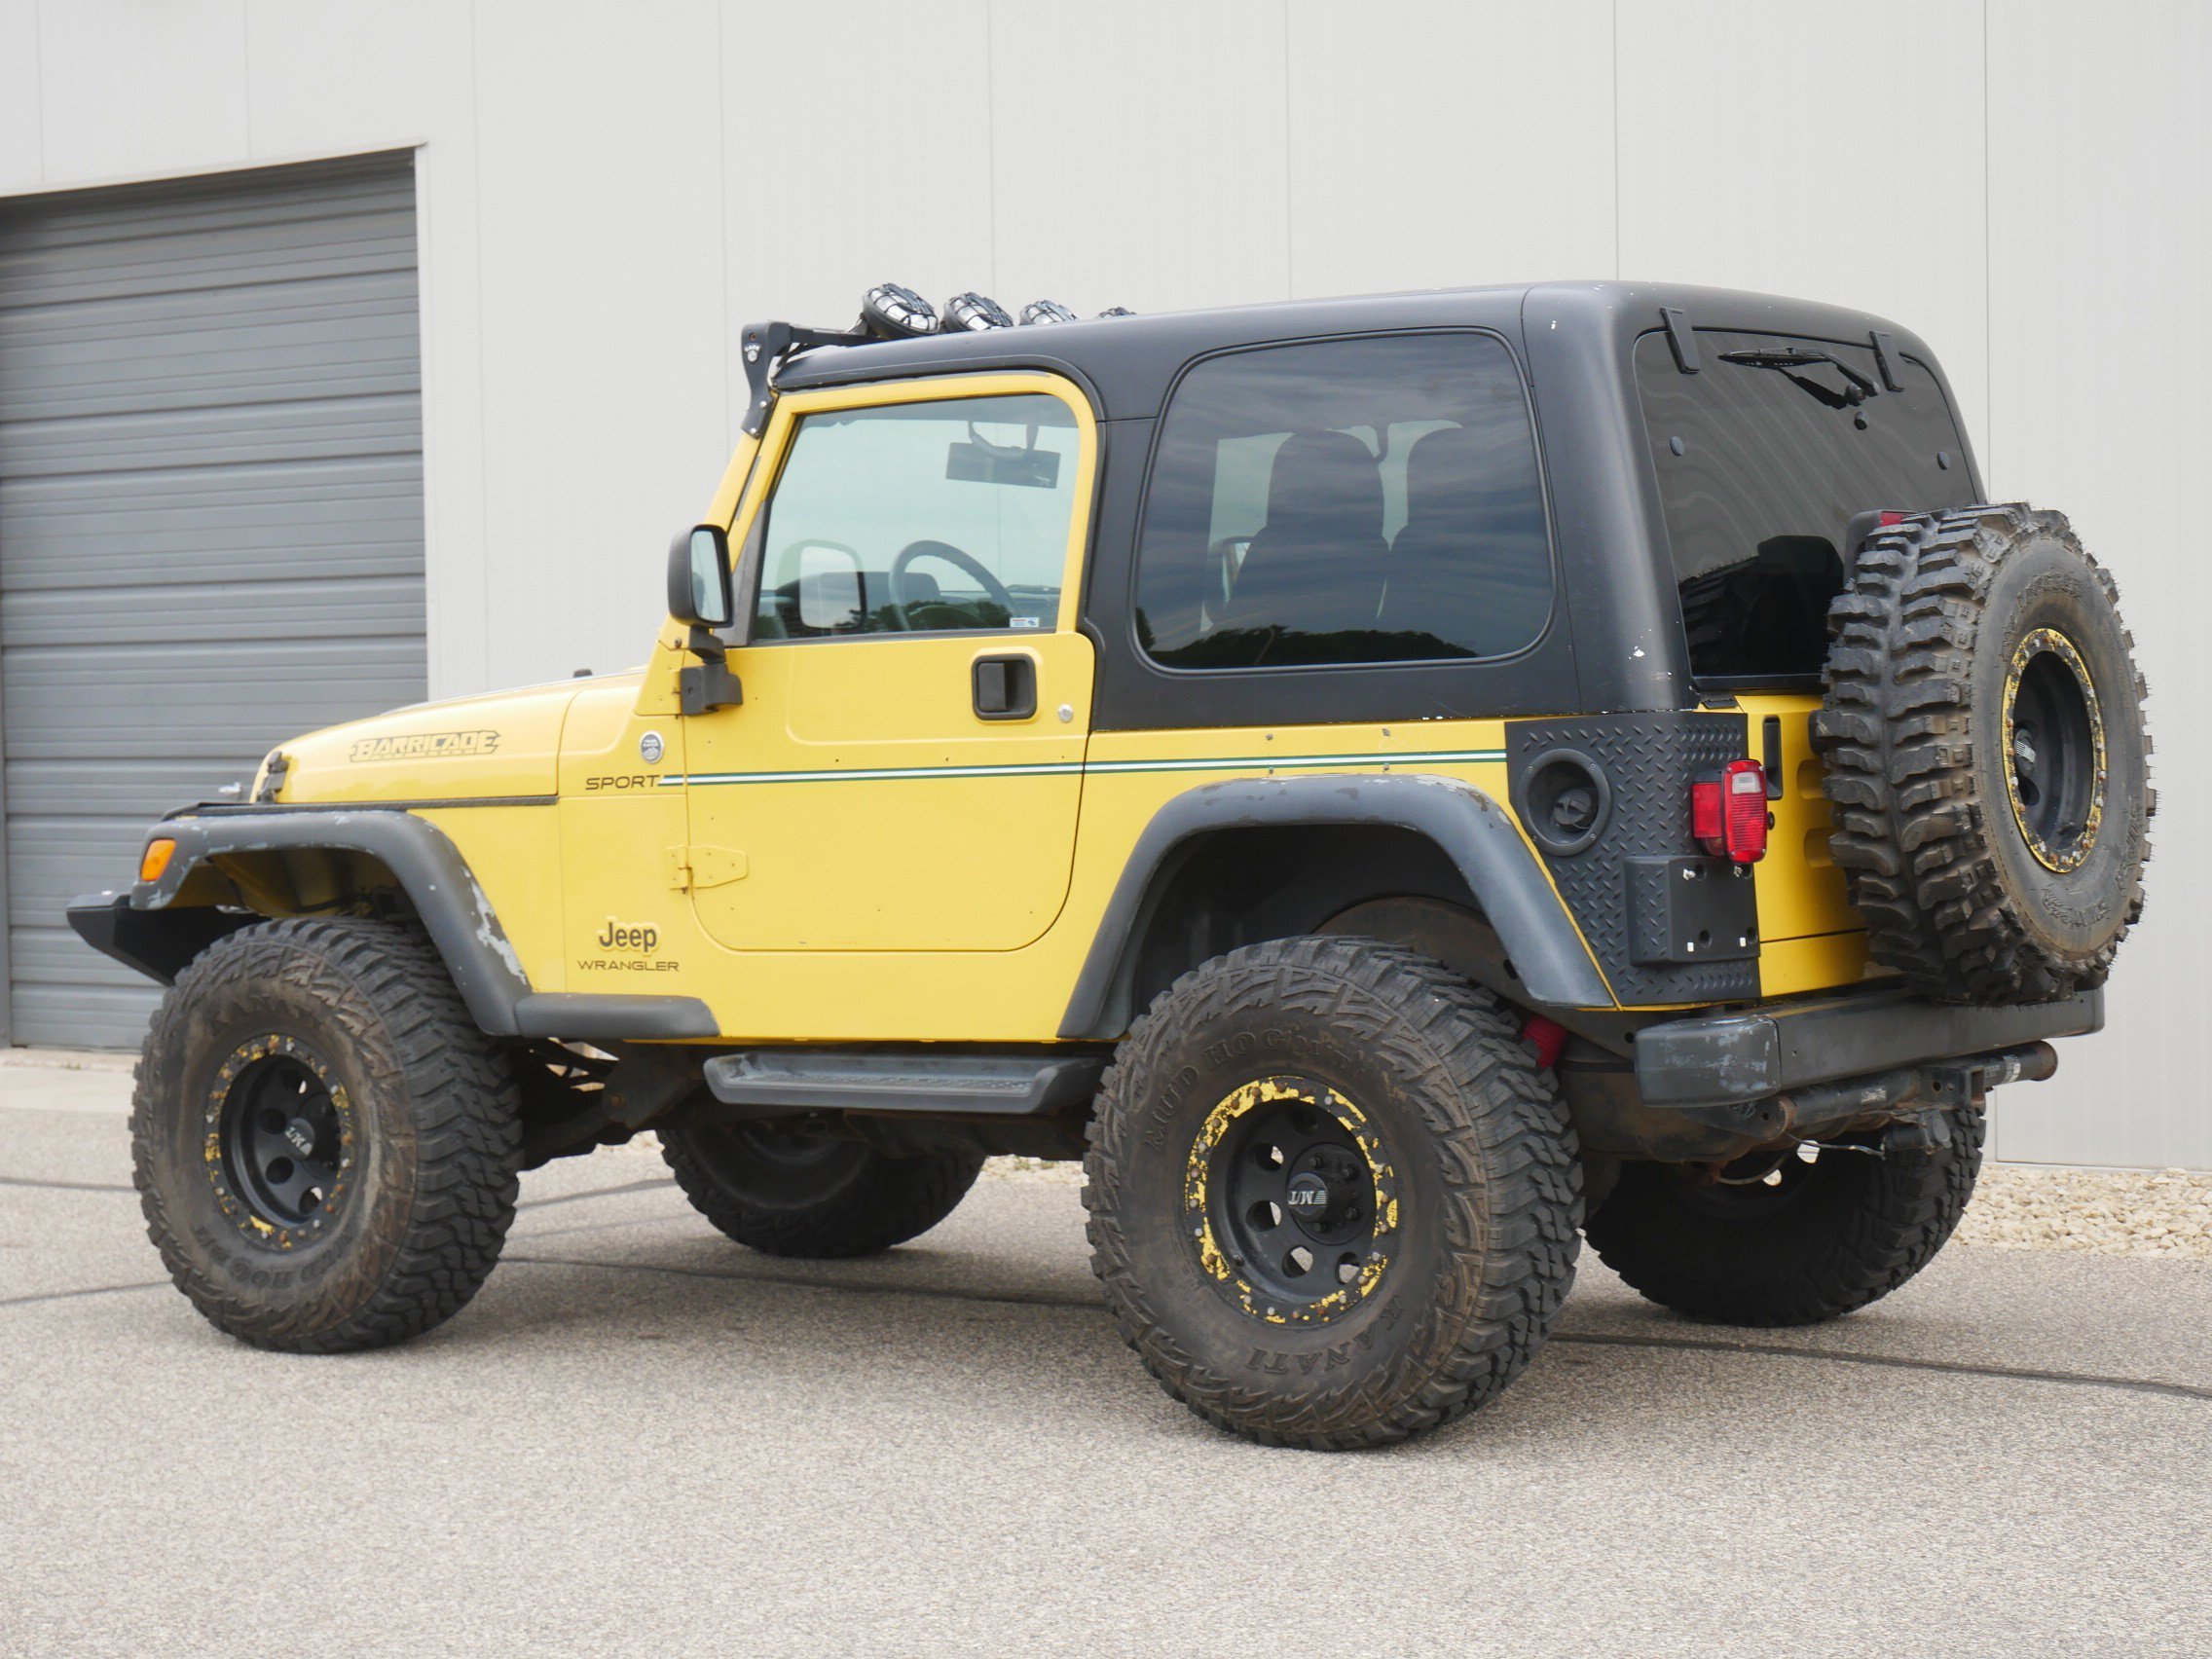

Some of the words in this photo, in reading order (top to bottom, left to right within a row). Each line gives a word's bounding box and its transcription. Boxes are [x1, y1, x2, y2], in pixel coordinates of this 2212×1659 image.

[350, 730, 499, 762] BARRICADE
[585, 775, 660, 791] SPORT
[599, 921, 657, 953] Jeep
[577, 960, 680, 972] WRANGLER
[1145, 1065, 1199, 1149] MUD
[1202, 1028, 1292, 1067] HOG
